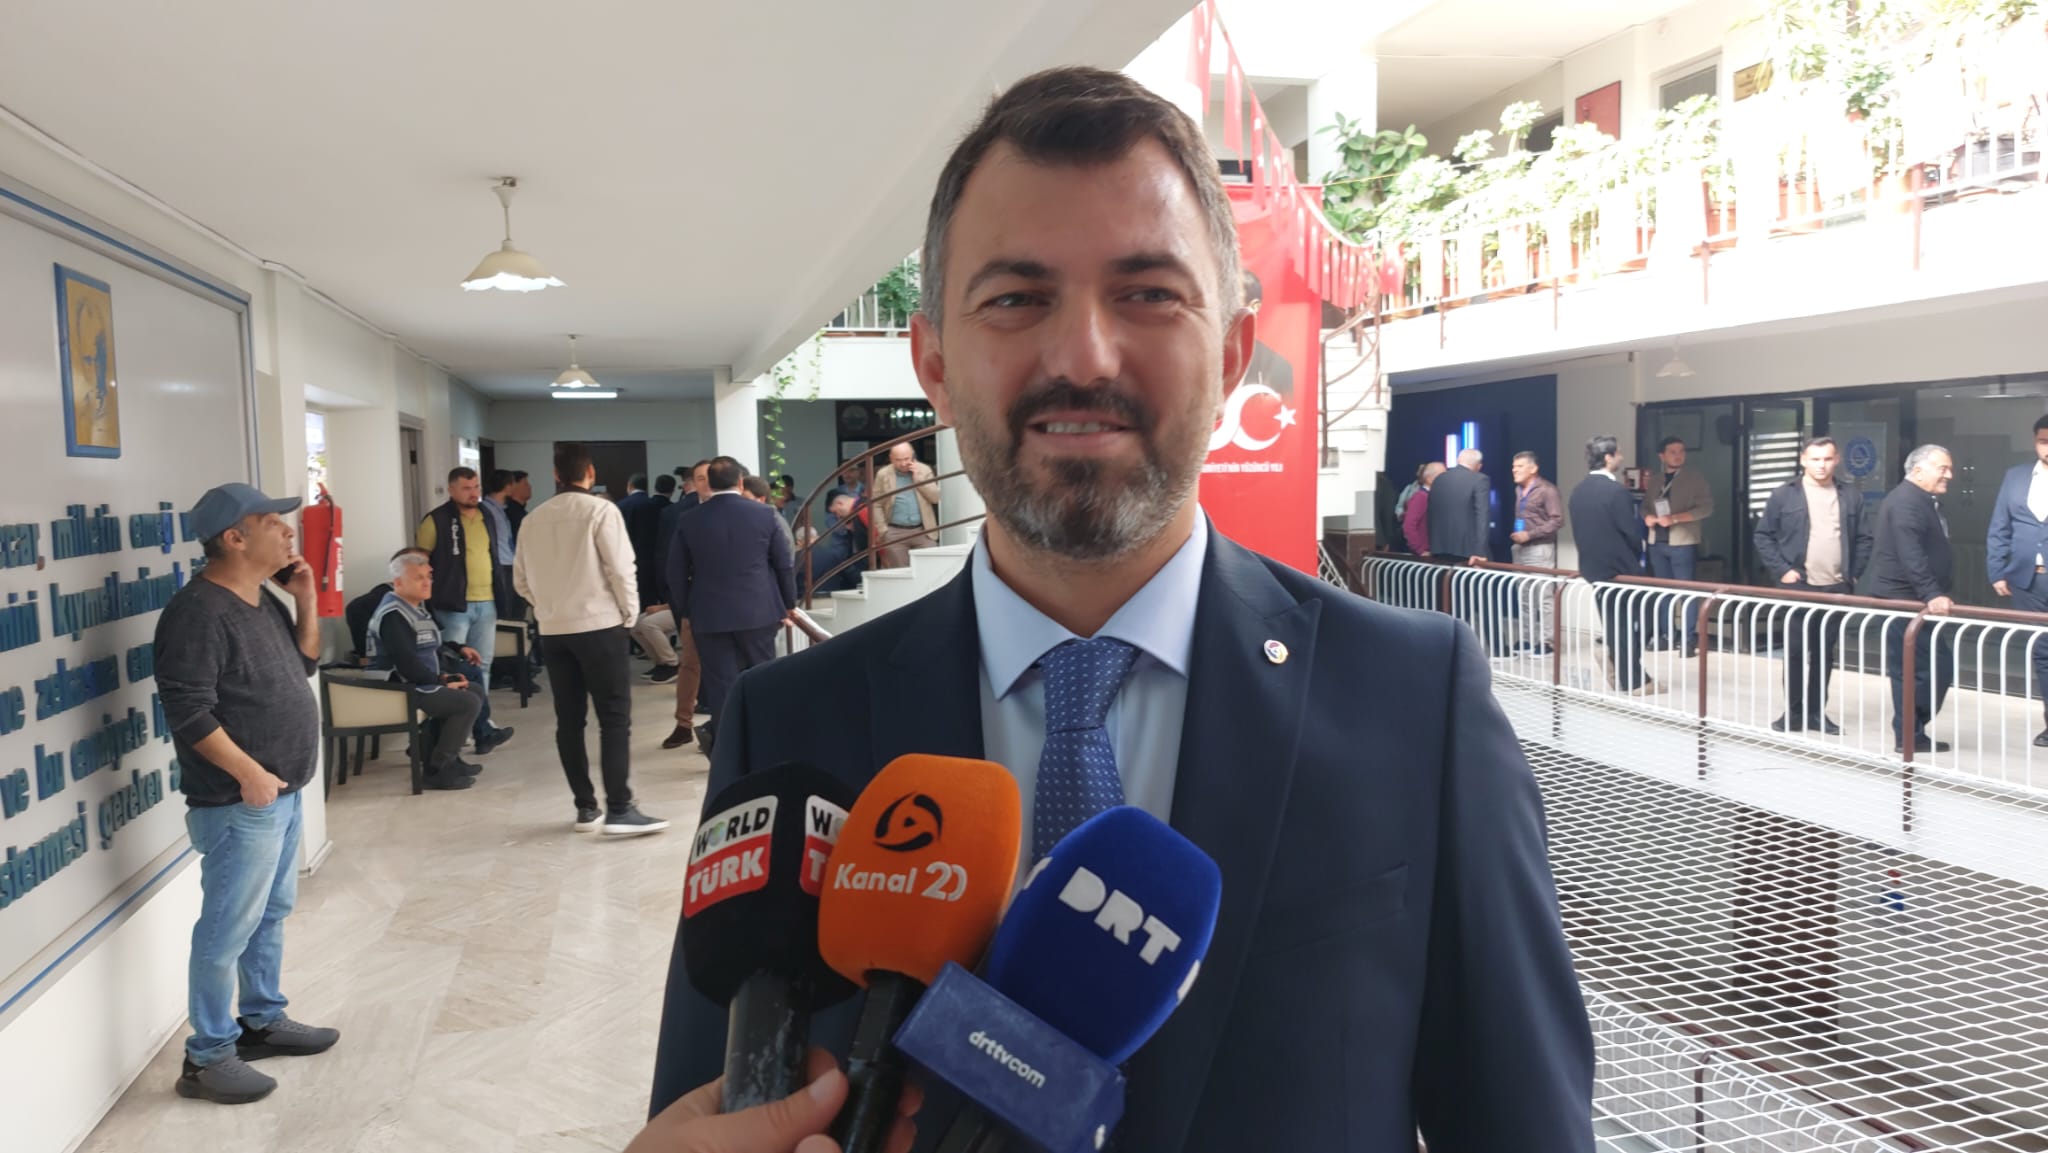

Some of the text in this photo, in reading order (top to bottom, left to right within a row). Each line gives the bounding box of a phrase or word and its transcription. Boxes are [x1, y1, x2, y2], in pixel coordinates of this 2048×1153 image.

[51, 504, 121, 560] milletin
[129, 501, 174, 554] emeği
[0, 768, 30, 820] ve
[34, 744, 65, 802] bu
[98, 769, 163, 850] gereken
[696, 807, 769, 856] WORLD
[689, 847, 765, 903] TÜRK
[833, 863, 917, 894] Kanal
[1057, 866, 1182, 965] DRT
